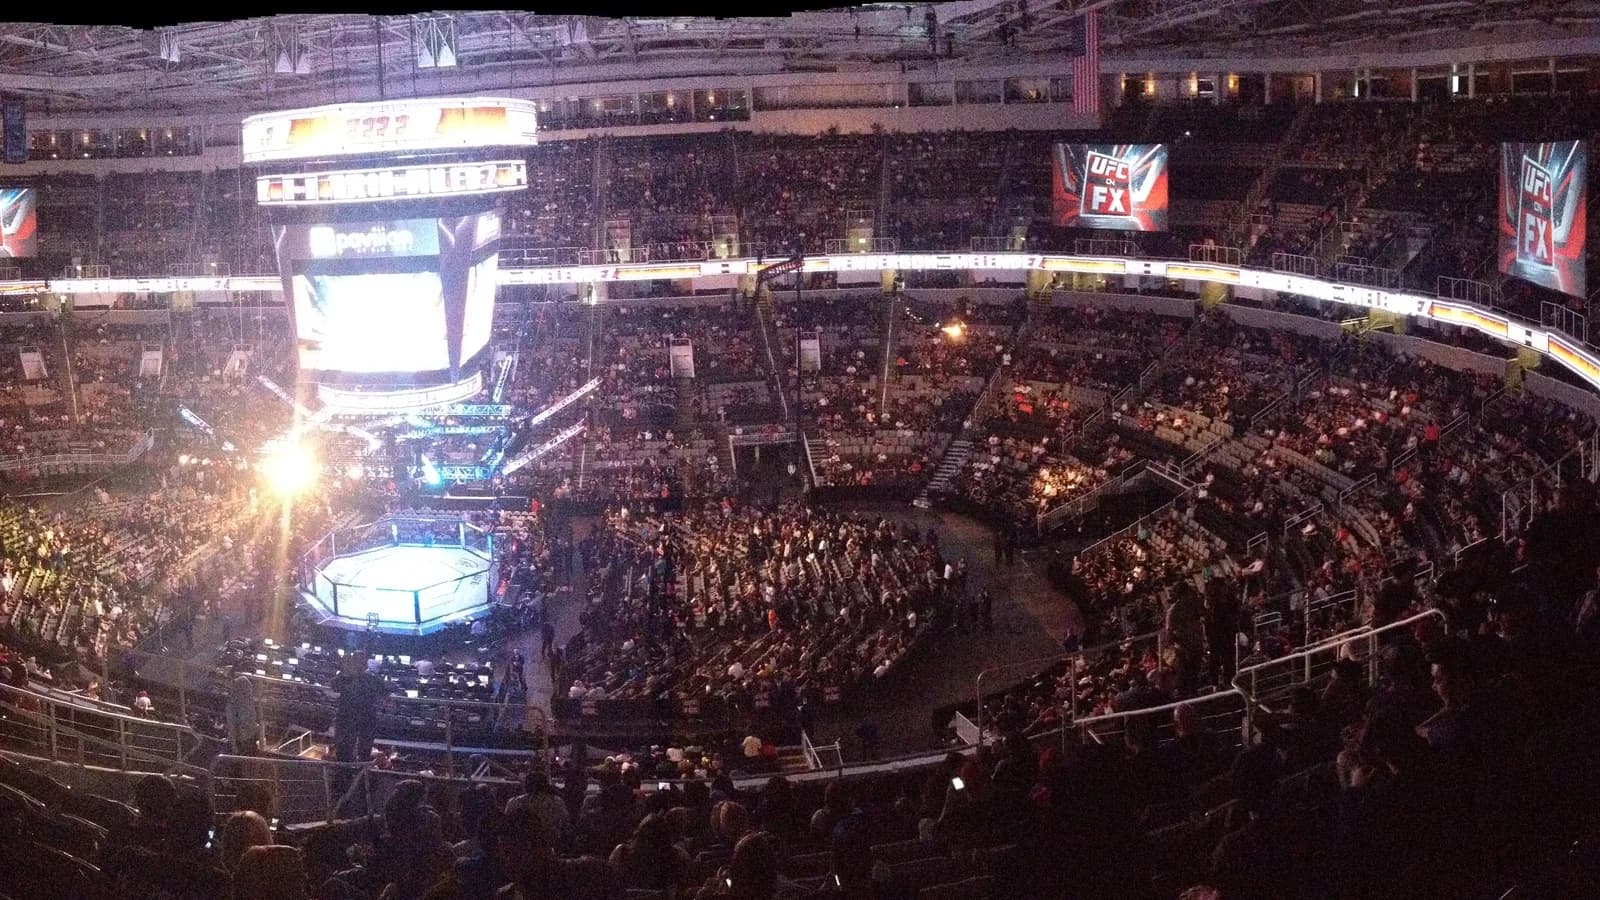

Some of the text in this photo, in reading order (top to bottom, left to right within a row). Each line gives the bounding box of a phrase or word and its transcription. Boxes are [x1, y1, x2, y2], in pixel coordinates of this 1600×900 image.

[1091, 157, 1129, 179] UFC
[1524, 164, 1550, 202] UFC
[1091, 186, 1126, 213] FX
[1524, 213, 1548, 259] FX
